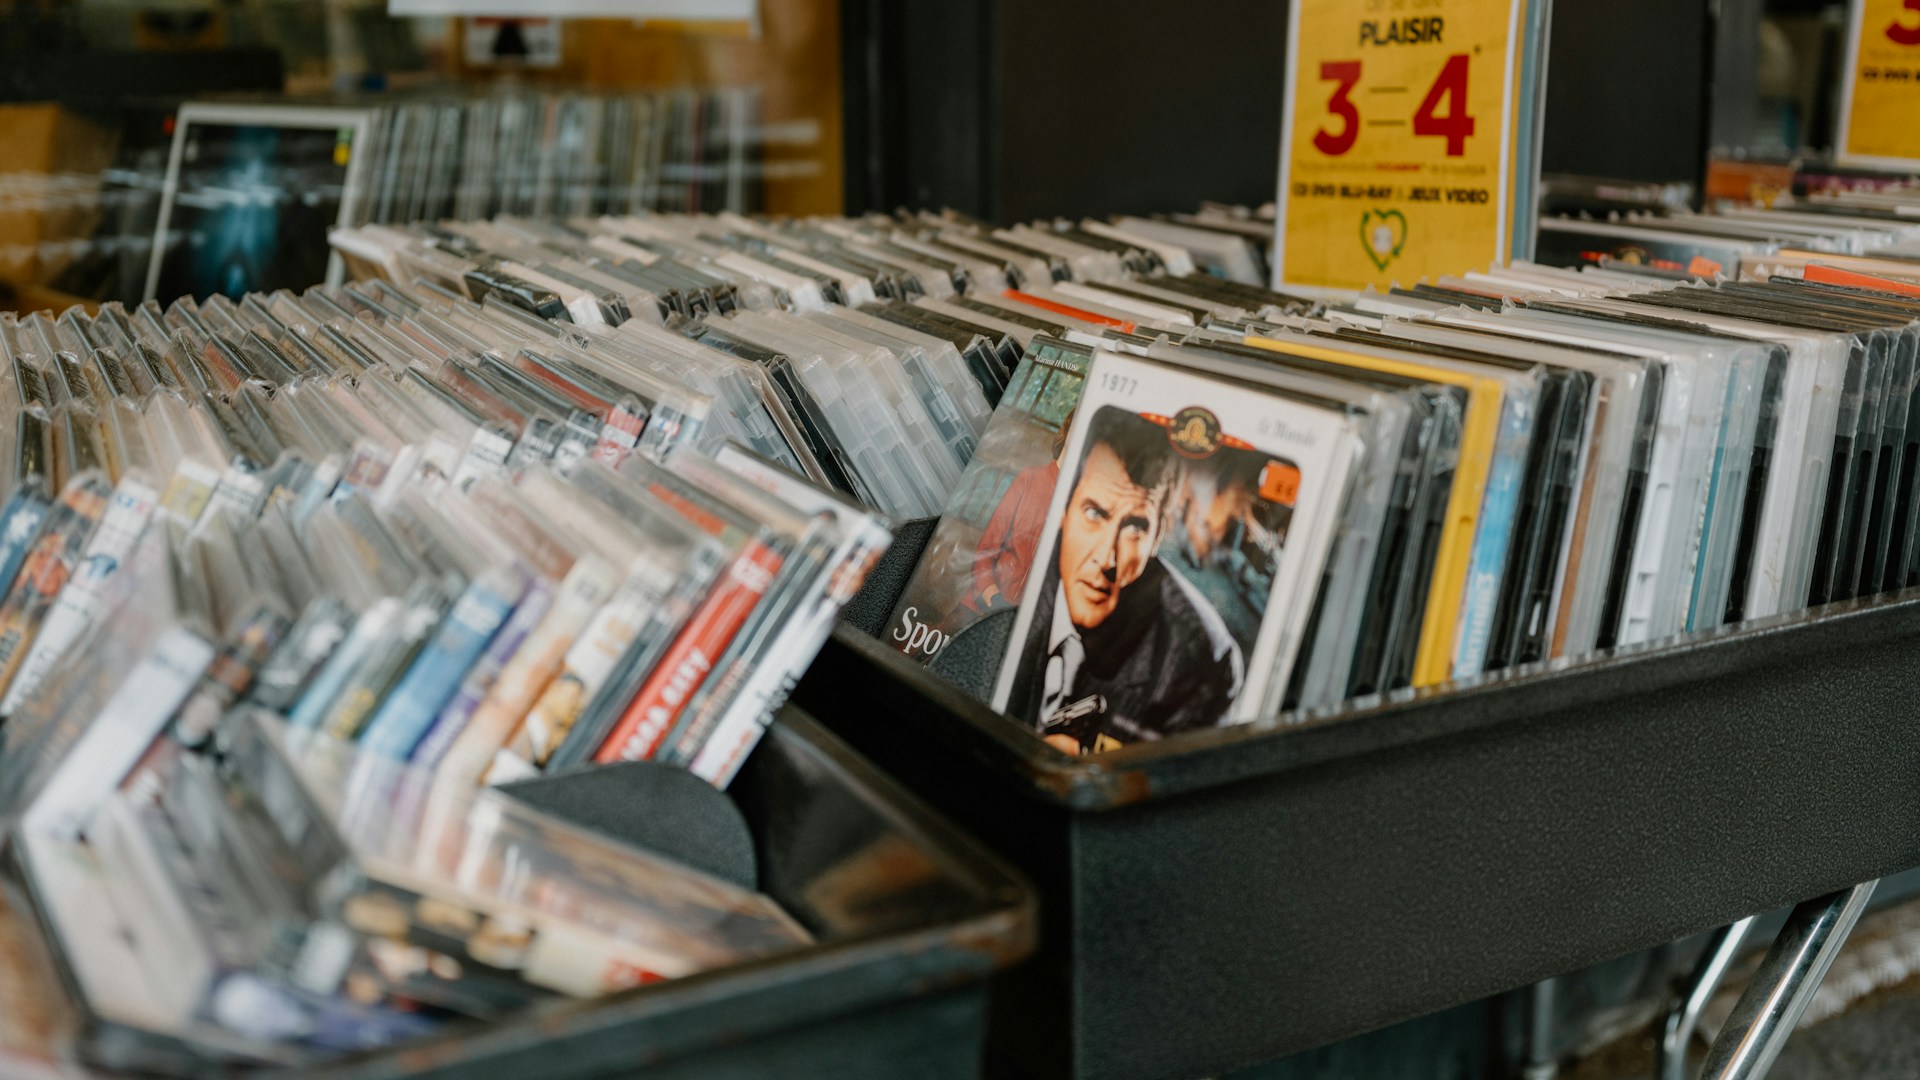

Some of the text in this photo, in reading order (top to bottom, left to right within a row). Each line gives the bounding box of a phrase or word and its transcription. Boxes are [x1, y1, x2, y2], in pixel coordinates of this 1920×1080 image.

[1359, 16, 1443, 46] PLAISIR
[1313, 61, 1362, 156] 3
[1312, 183, 1335, 197] DVD
[1340, 184, 1392, 199] BLU-RAY
[1409, 186, 1440, 202] JEUX
[1447, 188, 1489, 204] VIDEO
[1035, 354, 1078, 371] Marina HANDS
[1101, 372, 1138, 395] 1977
